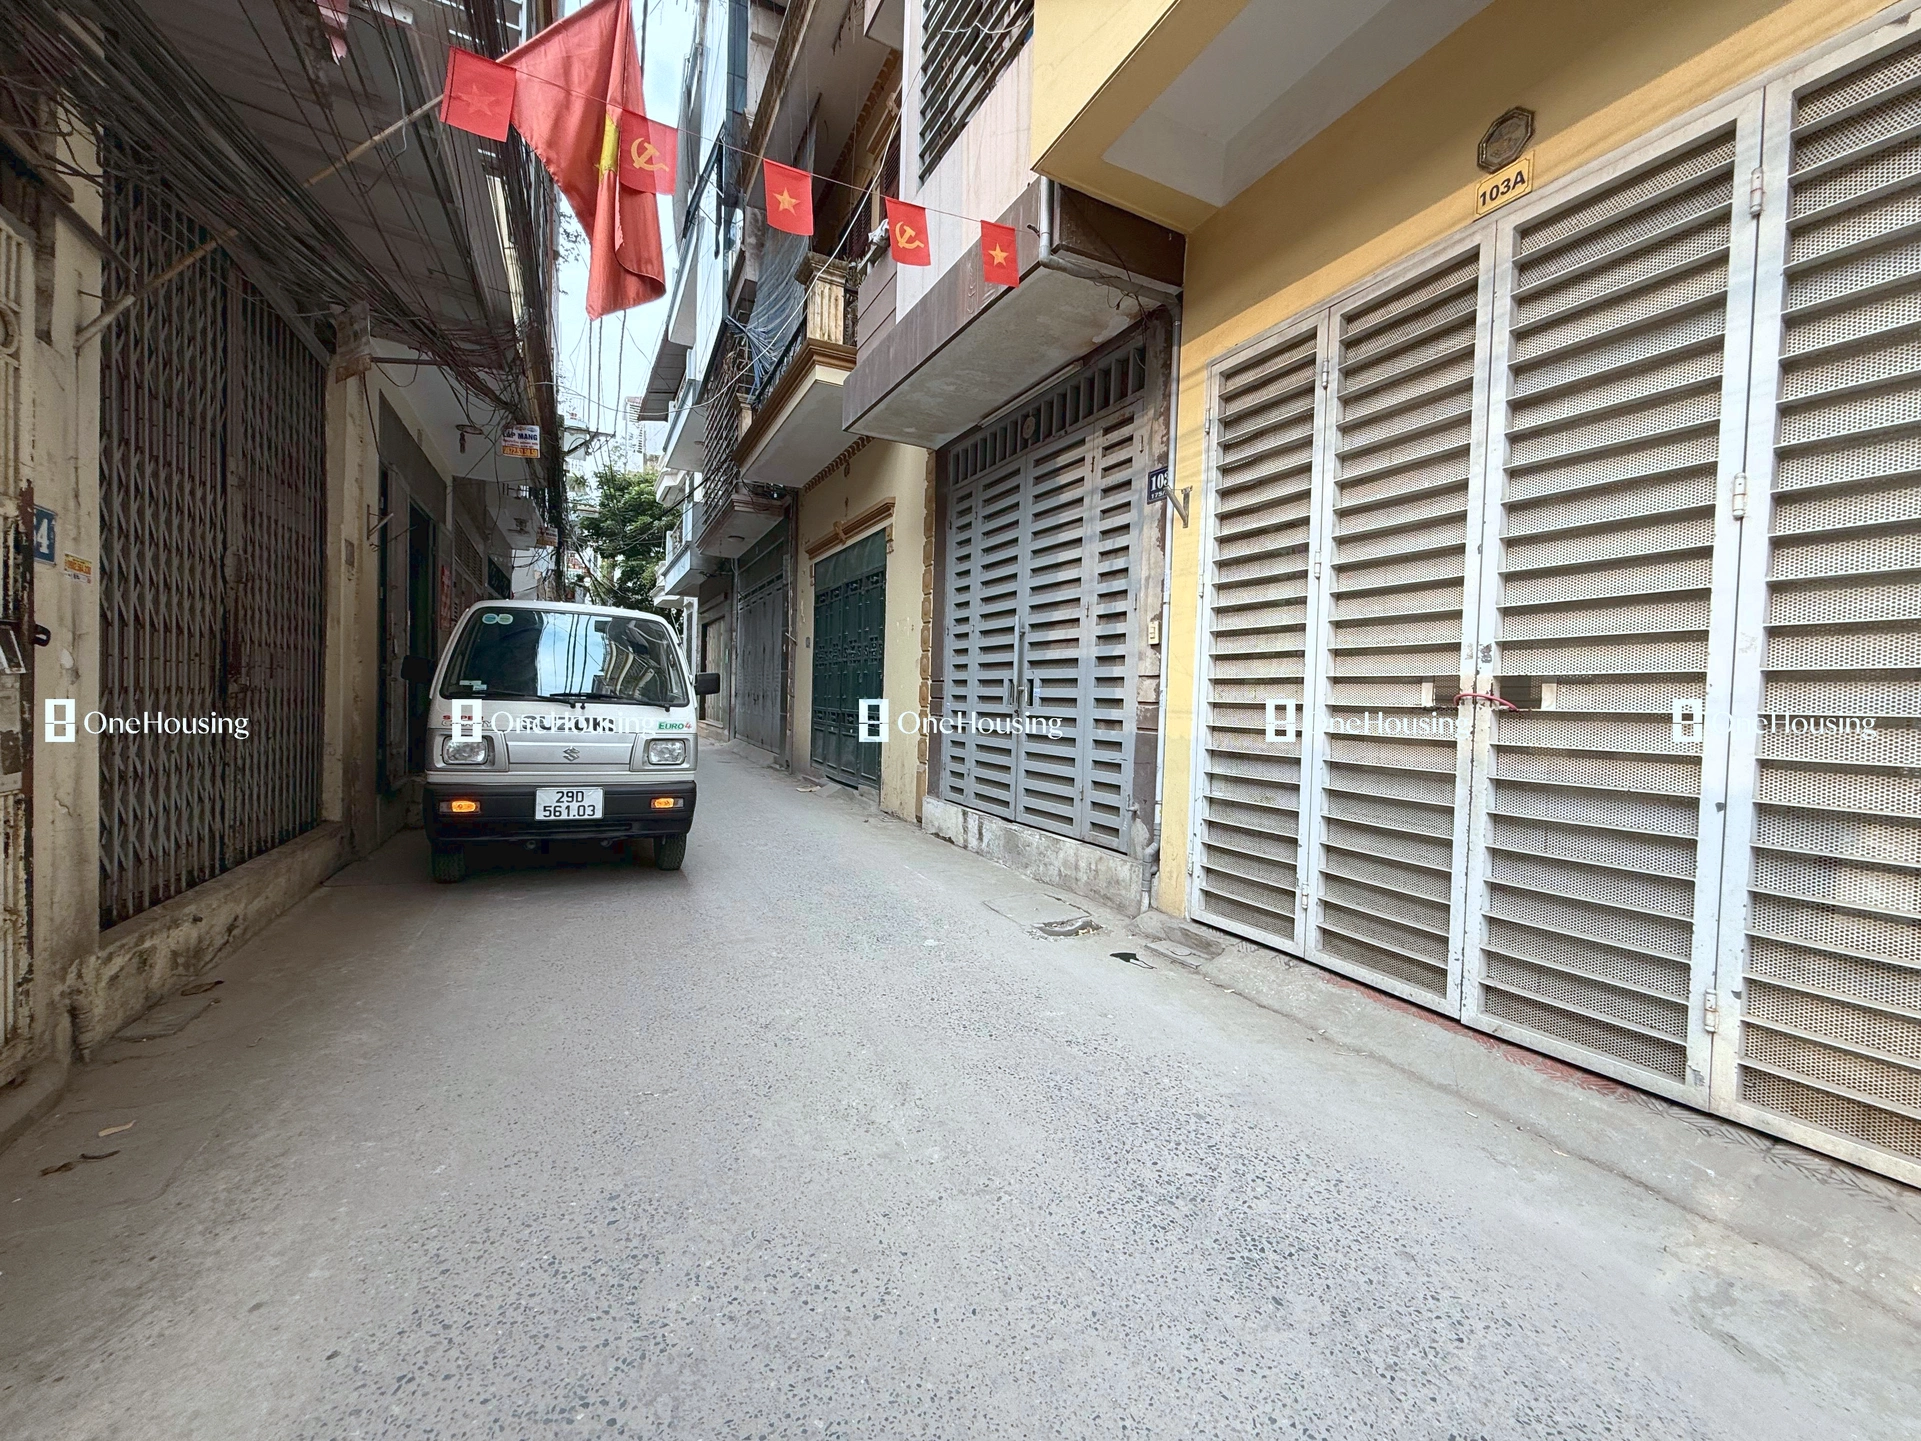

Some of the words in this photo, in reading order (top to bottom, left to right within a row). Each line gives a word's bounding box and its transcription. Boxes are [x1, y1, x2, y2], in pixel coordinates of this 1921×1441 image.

[1480, 170, 1526, 207] 103A
[34, 516, 50, 554] 4
[555, 790, 585, 804] 29D
[542, 804, 596, 818] 561.03
